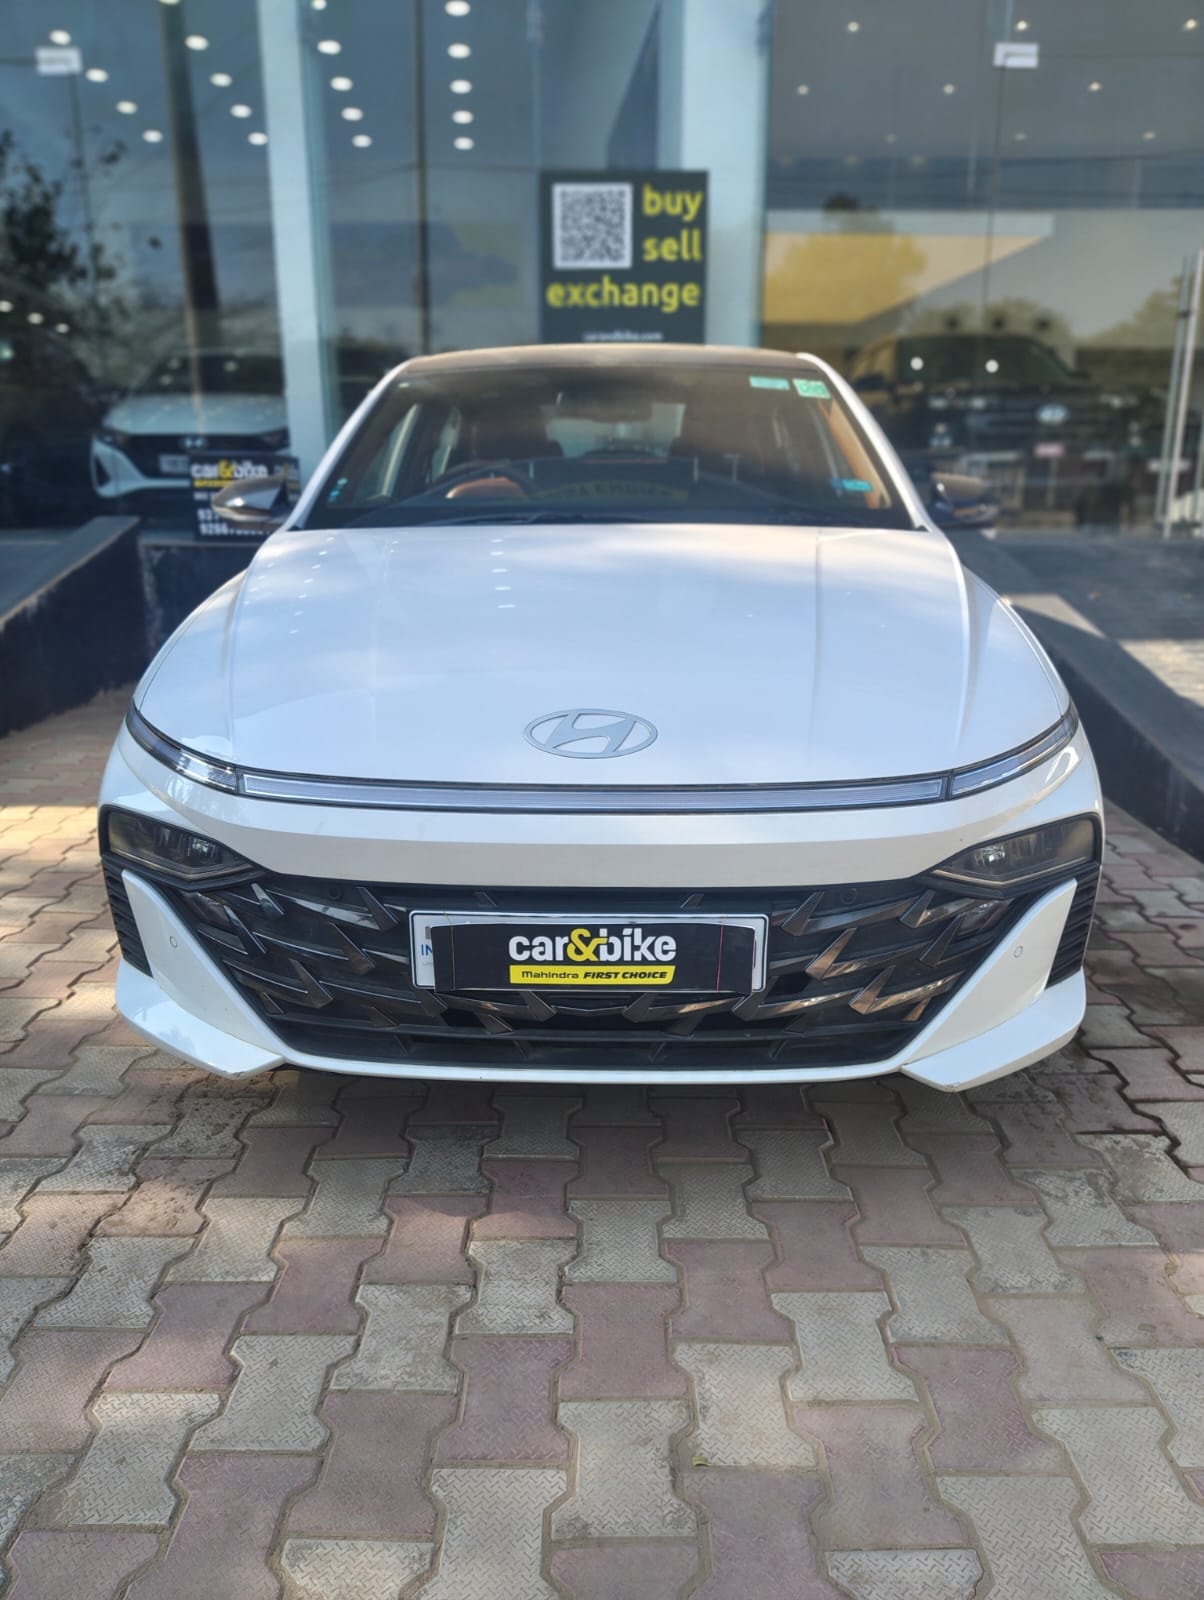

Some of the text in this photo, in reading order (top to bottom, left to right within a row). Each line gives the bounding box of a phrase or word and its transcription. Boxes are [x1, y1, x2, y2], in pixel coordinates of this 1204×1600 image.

[643, 184, 703, 222] buy
[643, 229, 702, 262] sell
[546, 275, 700, 313] exchange
[421, 944, 433, 956] IN
[509, 928, 677, 962] car&bike
[522, 970, 667, 980] Mahindra FIRST CHOICE
